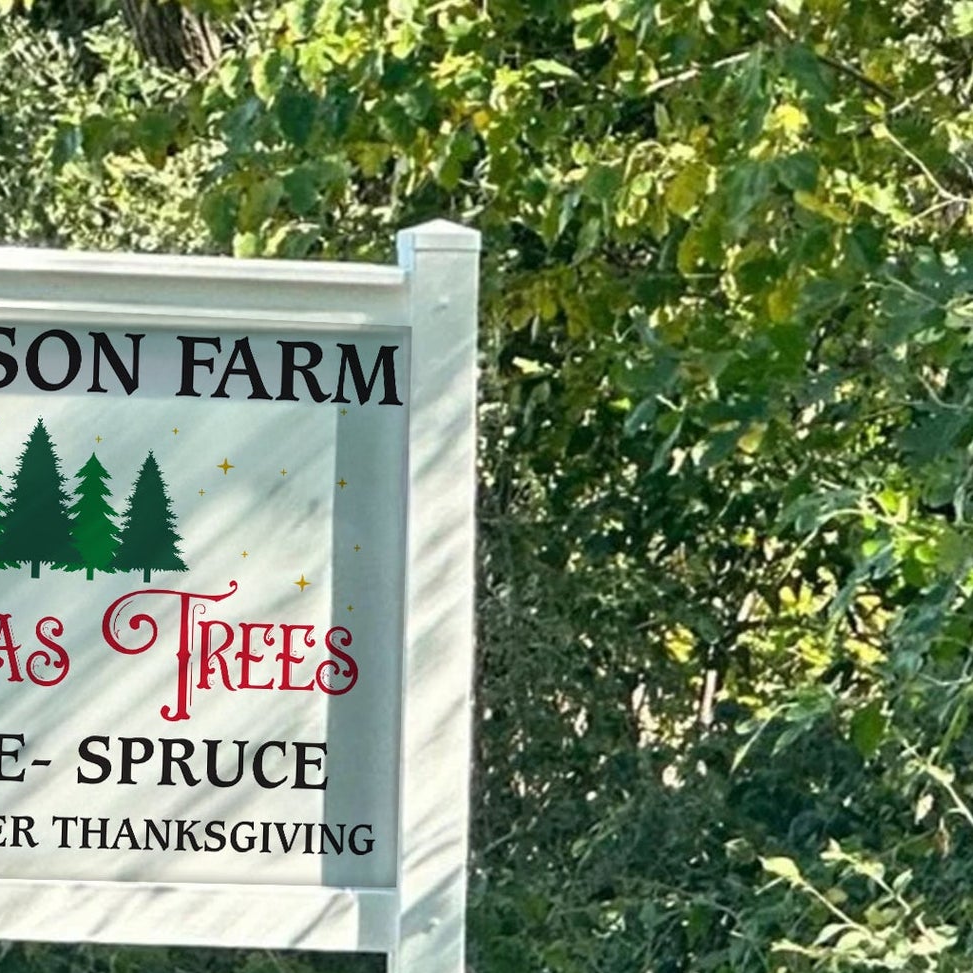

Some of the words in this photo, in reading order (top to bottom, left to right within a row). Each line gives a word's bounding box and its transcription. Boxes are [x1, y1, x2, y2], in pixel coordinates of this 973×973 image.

[175, 335, 404, 407] FARM
[77, 735, 329, 791] SPRUCE
[52, 815, 376, 856] THANKSGIVING
